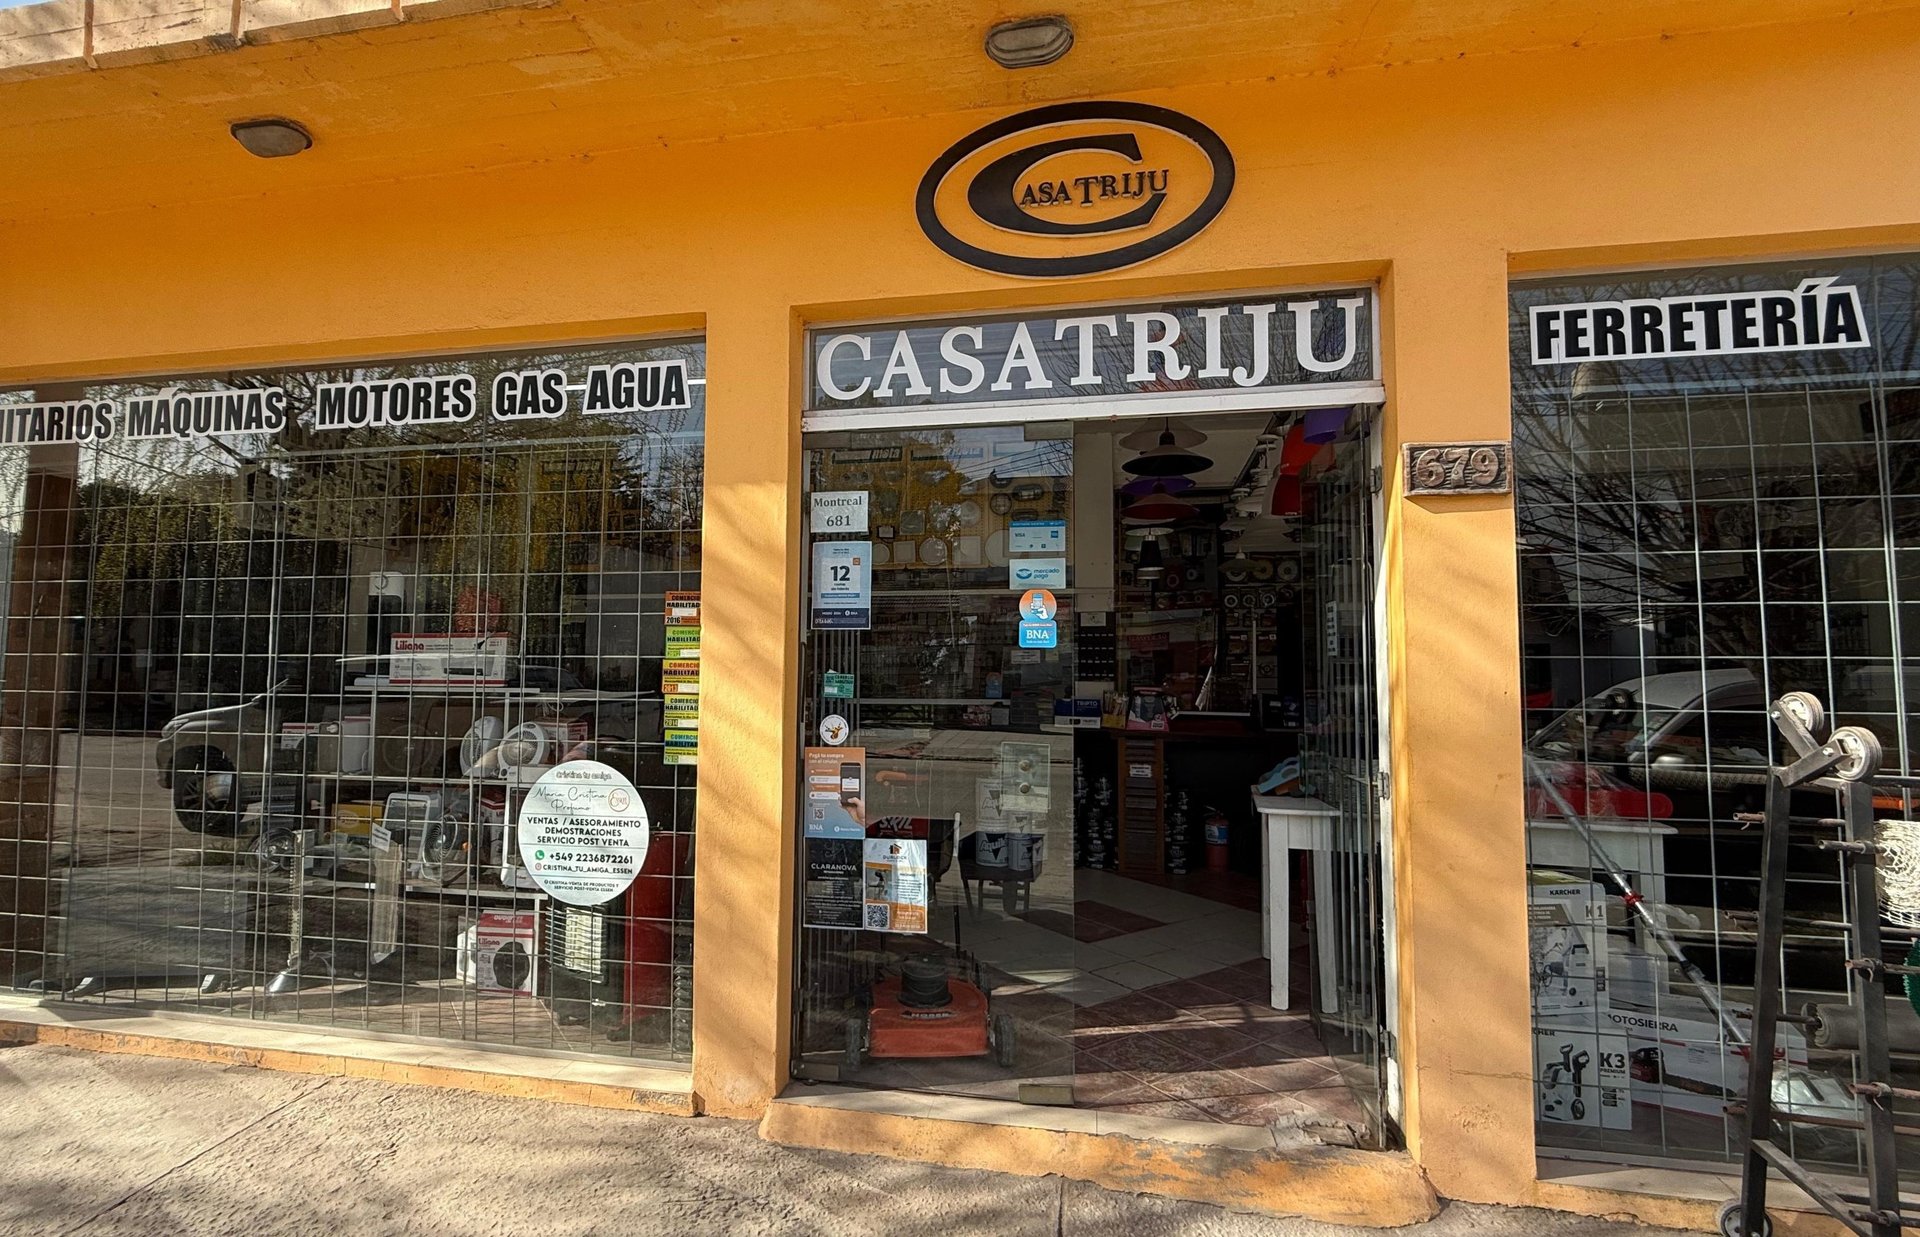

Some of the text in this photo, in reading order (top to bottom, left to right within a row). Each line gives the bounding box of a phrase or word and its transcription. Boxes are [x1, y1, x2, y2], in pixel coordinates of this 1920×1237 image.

[1536, 283, 1863, 358] FERRETERÍA
[816, 297, 1365, 400] CASATRIJU
[318, 377, 474, 426] MOTORES
[495, 373, 564, 417] GAS
[586, 364, 686, 410] AGUA
[1415, 447, 1500, 487] 679
[814, 495, 862, 507] Montreal
[826, 515, 851, 527] 681
[830, 565, 850, 581] 12
[1026, 630, 1049, 639] BNA
[395, 641, 424, 650] Liliana
[527, 817, 558, 825] VENTAS
[569, 818, 641, 828] ASESORAMIENTO
[545, 827, 621, 837] DEMOSTRACIONES
[537, 836, 576, 845] SERVICIO
[602, 839, 629, 847] VENTA
[550, 853, 633, 864] +549 2236872261
[811, 863, 857, 871] CLARANOVA
[1600, 1052, 1625, 1068] K3
